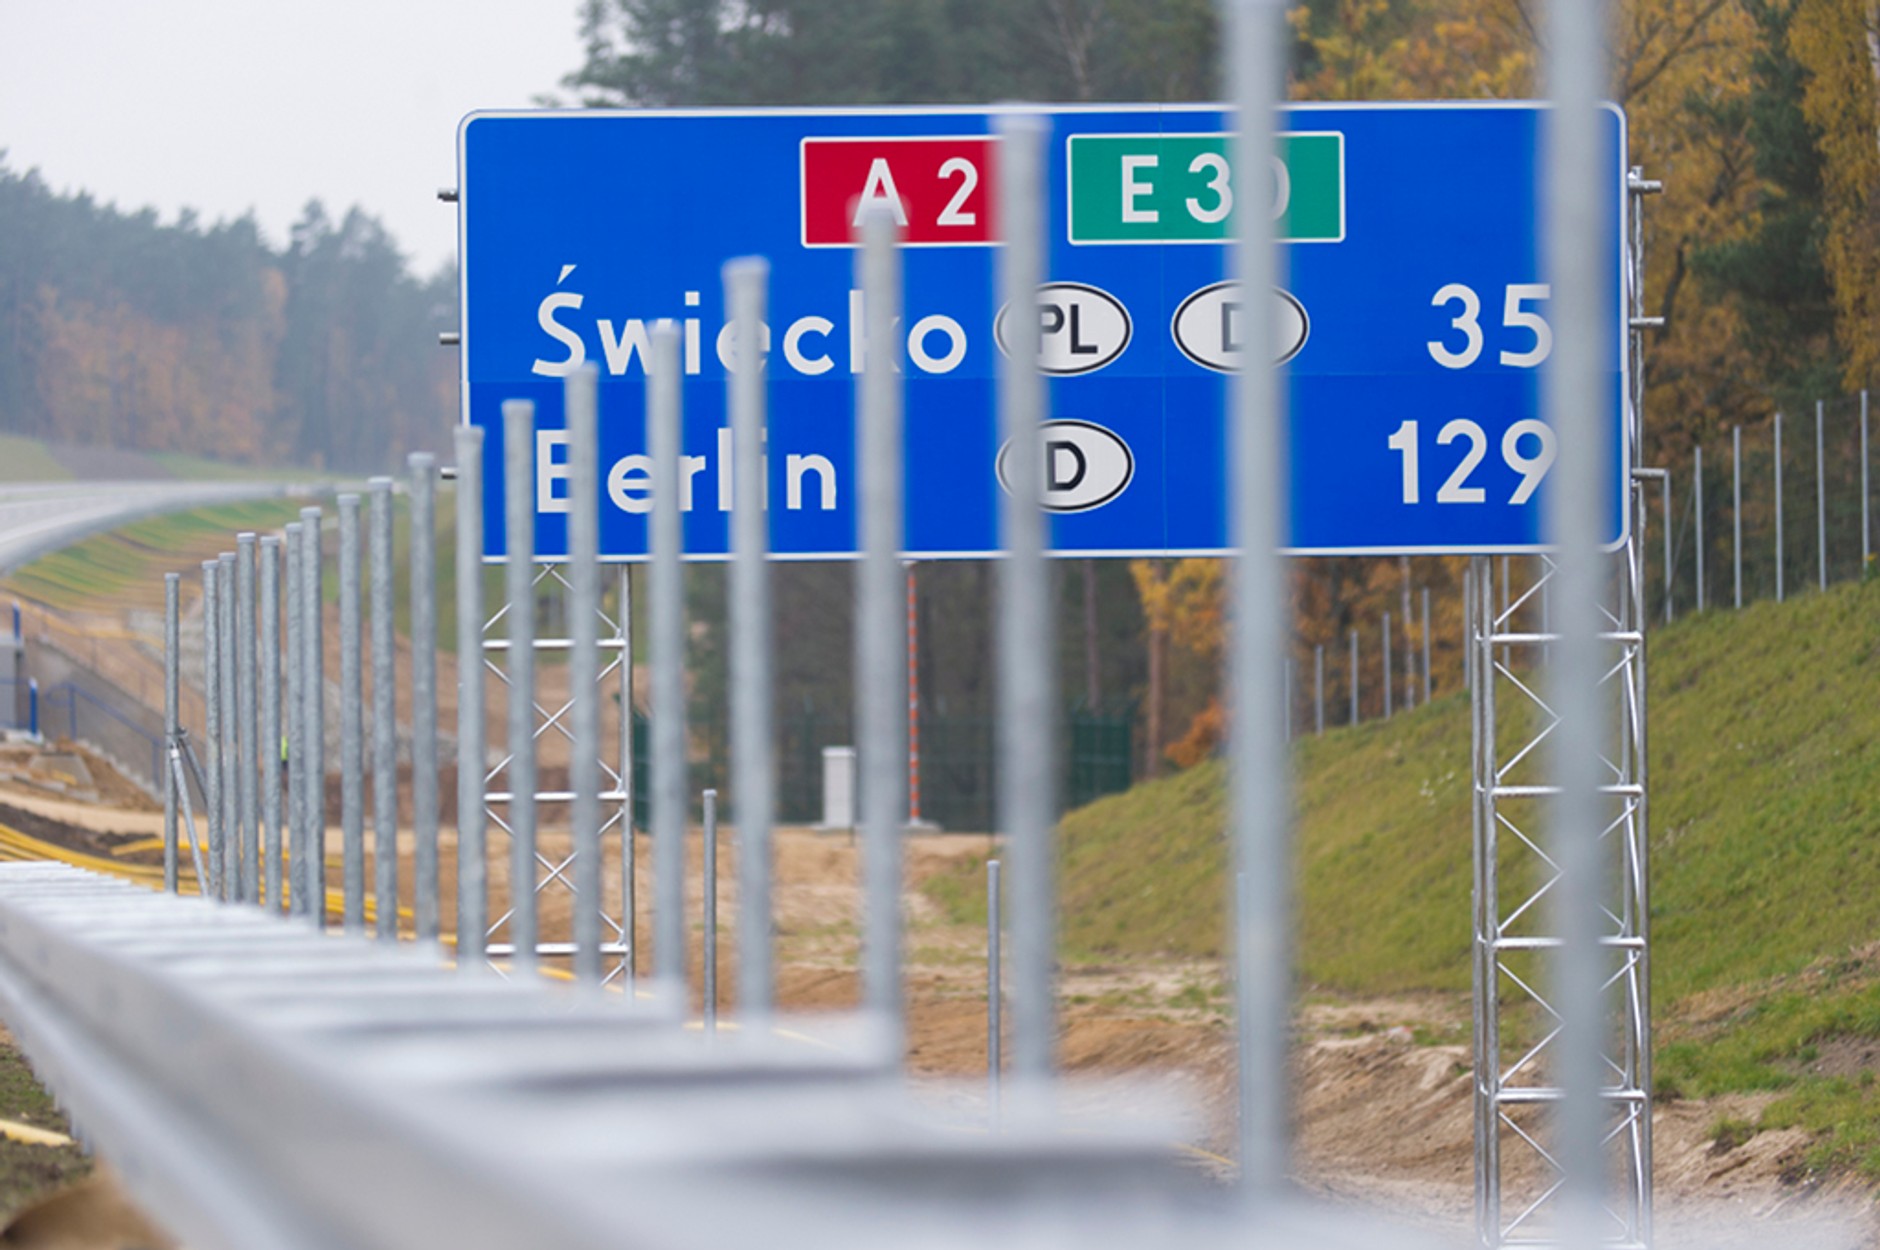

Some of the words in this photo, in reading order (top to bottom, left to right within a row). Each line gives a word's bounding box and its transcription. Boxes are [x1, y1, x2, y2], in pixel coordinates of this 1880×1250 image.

[852, 157, 909, 227] A
[936, 156, 979, 226] 2
[1121, 154, 1160, 224] E
[1034, 303, 1099, 355] PL
[1426, 282, 1553, 370] 35
[1045, 440, 1088, 492] D
[1387, 417, 1558, 506] 129
